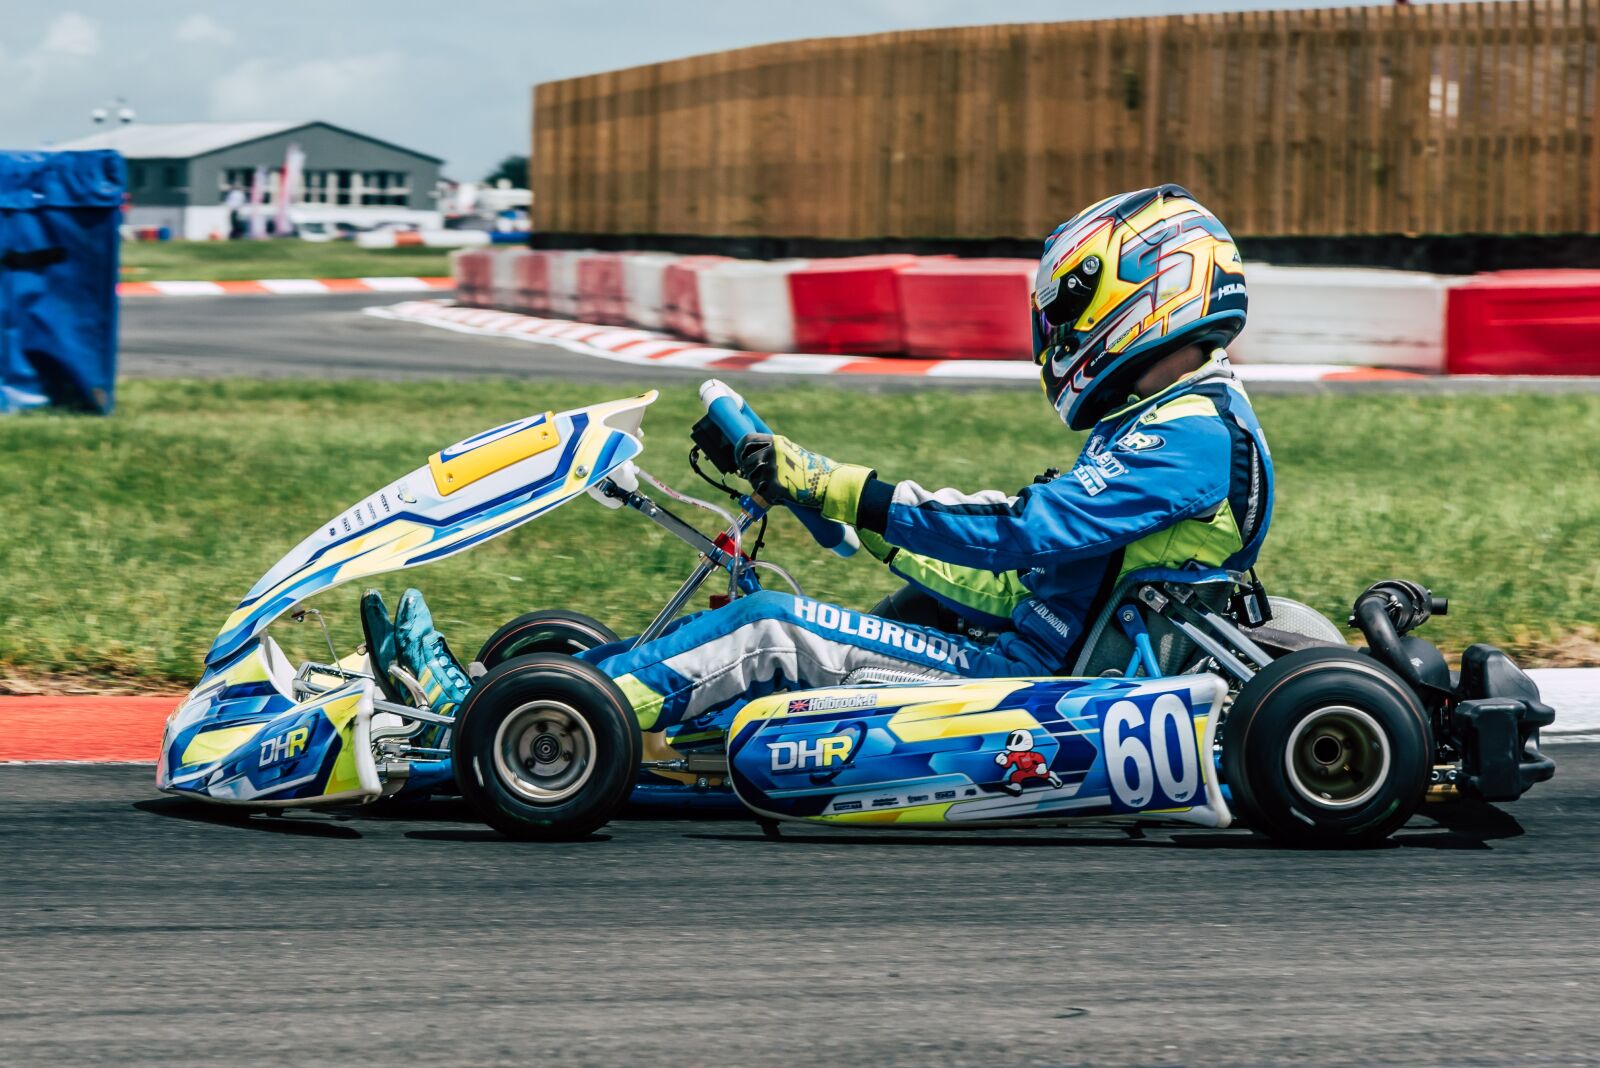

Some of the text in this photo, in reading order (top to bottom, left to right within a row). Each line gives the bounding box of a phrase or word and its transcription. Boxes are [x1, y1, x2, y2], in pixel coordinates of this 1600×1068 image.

[794, 597, 970, 669] HOLBROOK
[258, 727, 309, 767] DHR
[766, 735, 853, 771] DHR
[1103, 694, 1198, 807] 60
